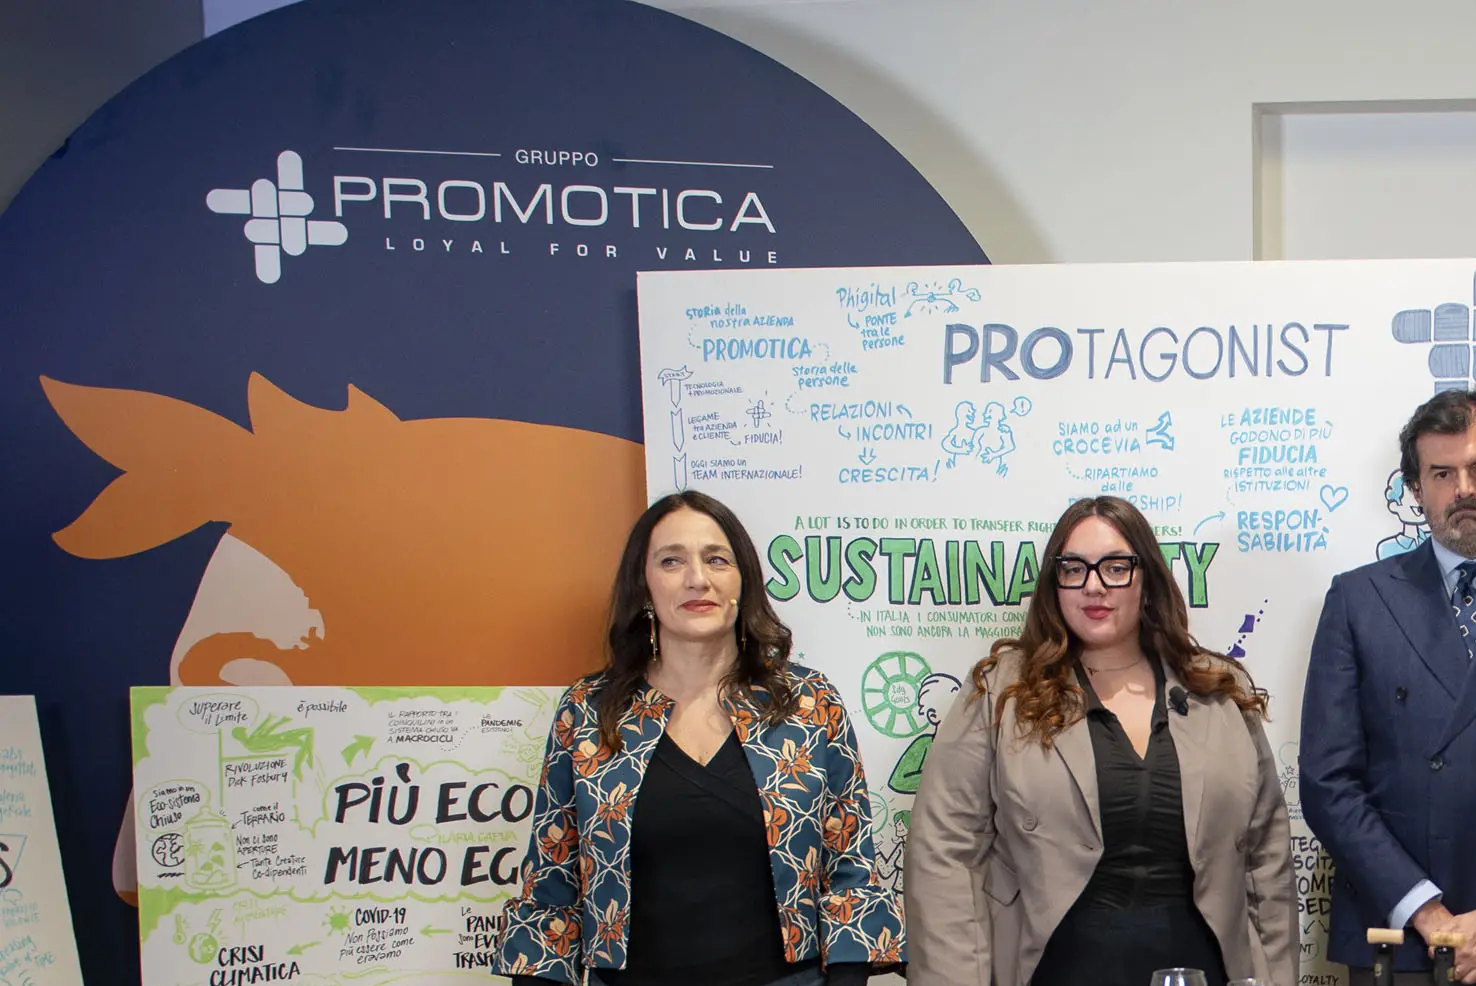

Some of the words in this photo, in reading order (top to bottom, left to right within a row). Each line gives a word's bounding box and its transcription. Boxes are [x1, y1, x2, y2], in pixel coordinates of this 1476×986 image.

[515, 149, 599, 168] GRUPPO
[334, 175, 777, 234] PROMOTICA
[386, 237, 511, 255] LOYAL
[551, 243, 618, 259] FOR
[657, 247, 778, 264] VALUE
[753, 315, 794, 327] AZIENDA
[865, 312, 897, 326] PONTE
[703, 337, 812, 362] PROMOTICA
[943, 321, 1350, 385] PROTAGONIST
[798, 375, 849, 388] persone
[688, 412, 720, 424] LEGAME
[810, 400, 892, 421] RELAZIONI
[1240, 407, 1316, 427] AZIENDE
[745, 430, 783, 445] FIDUCIA!
[856, 423, 932, 442] INCONTRI
[1058, 421, 1099, 436] SIAMO
[1230, 428, 1290, 445] GODONO
[1053, 438, 1141, 456] CROCEVIA
[1238, 444, 1317, 465] FIDUCIA
[692, 469, 718, 480] TEAM
[721, 465, 803, 480] INTERNAZIONALE!
[710, 460, 735, 468] SIAMO
[839, 459, 940, 483] CRESCITA!
[1084, 466, 1159, 480] RIPARTIAMO
[1224, 467, 1271, 478] RISPETTO
[1101, 480, 1134, 493] dalle
[1234, 480, 1310, 492] ISTITUZIONI
[808, 517, 830, 530] LOT
[837, 517, 850, 529] IS
[854, 517, 870, 529] TO
[872, 518, 889, 529] DO
[895, 518, 908, 530] IN
[911, 518, 947, 530] ORDER
[953, 518, 967, 530] TO
[971, 518, 1024, 532] TRANSFER
[1237, 509, 1322, 530] RESPON-
[1237, 527, 1329, 552] SABILITÀ
[765, 534, 1220, 608] SUSTAINATY
[871, 611, 909, 622] ITALIA
[927, 612, 997, 623] CONSUMATORI
[867, 625, 886, 637] NON
[890, 625, 912, 637] SONO
[918, 626, 953, 637] ANCORA
[225, 759, 287, 776] RIVOLUZIONE
[435, 781, 533, 824] ECO
[324, 845, 447, 885] MENO
[461, 846, 519, 886] EG
[355, 907, 406, 926] COVID-19
[356, 943, 386, 955] essere
[392, 937, 415, 948] come
[218, 944, 265, 967] CRISI
